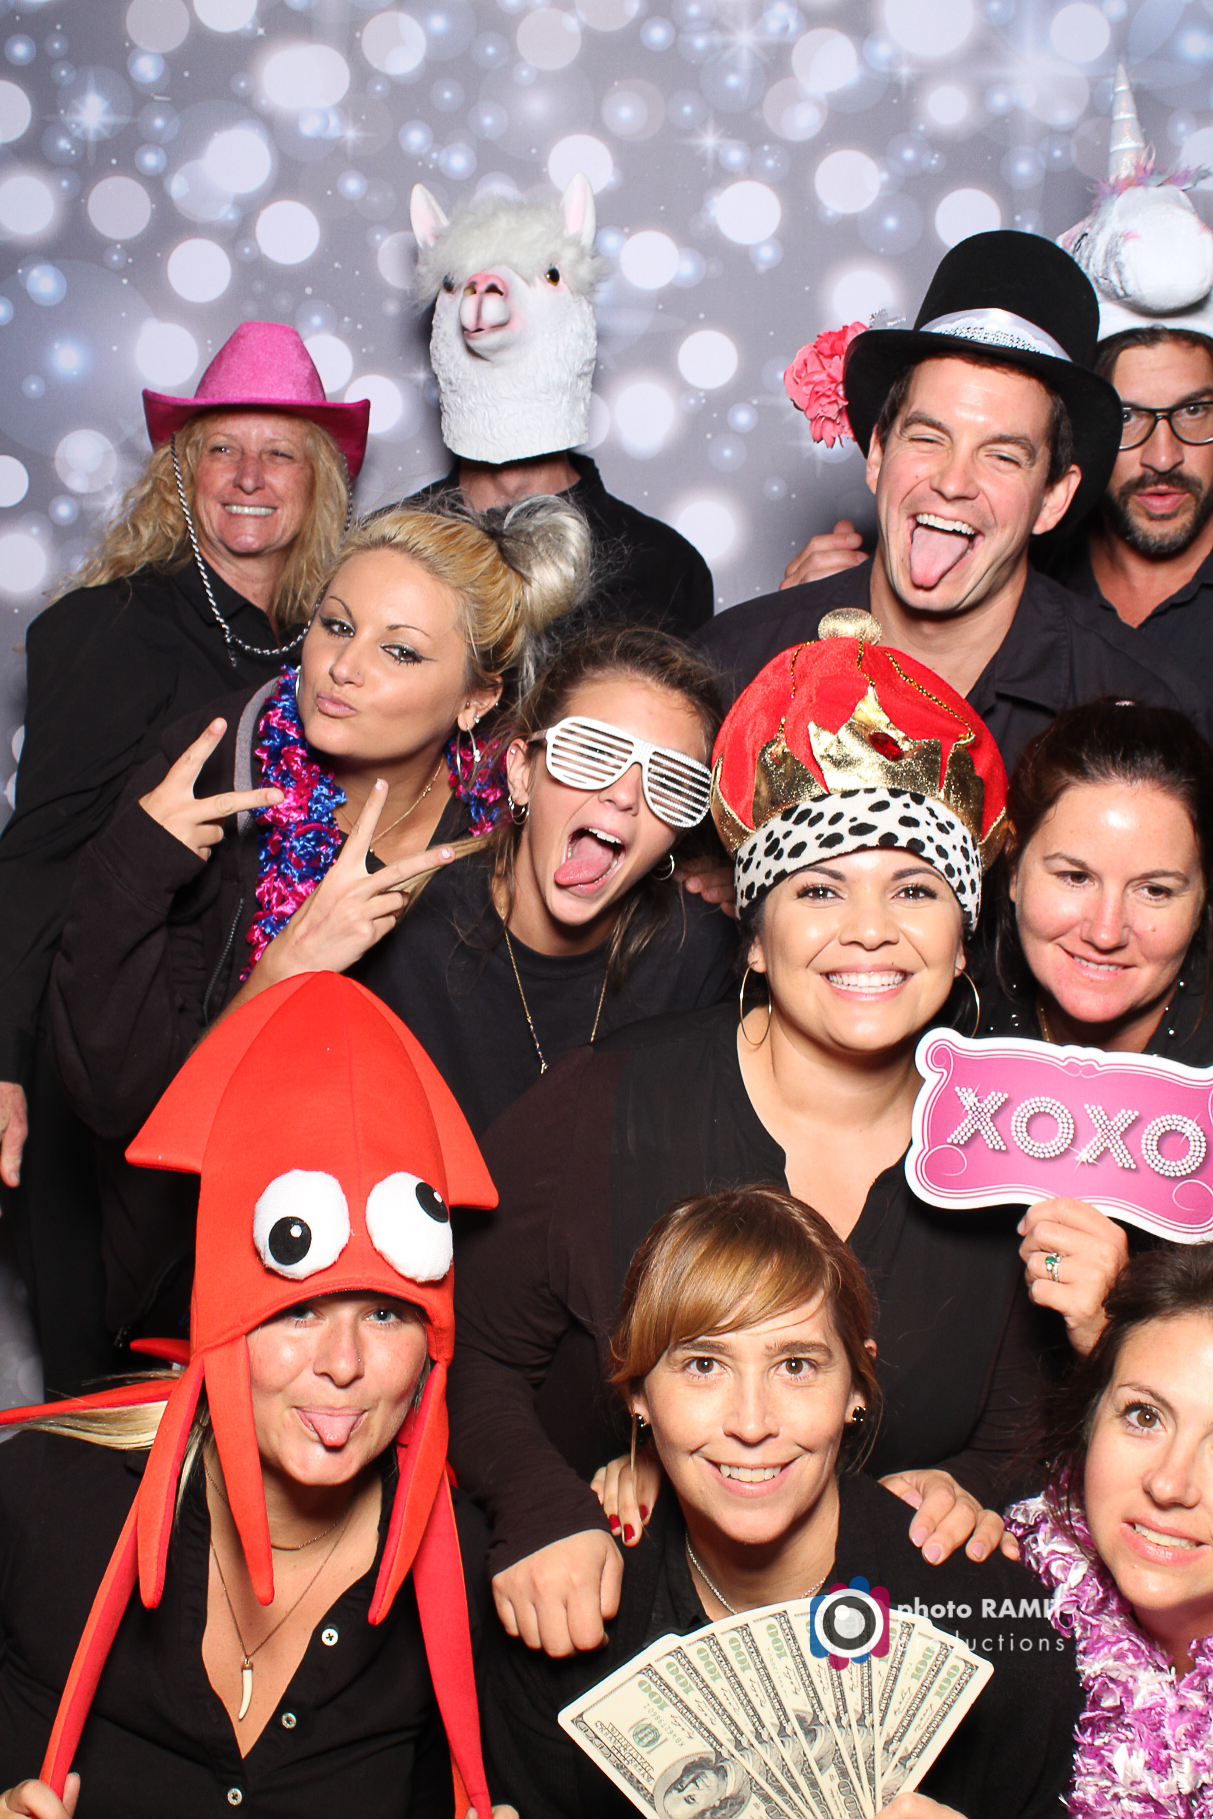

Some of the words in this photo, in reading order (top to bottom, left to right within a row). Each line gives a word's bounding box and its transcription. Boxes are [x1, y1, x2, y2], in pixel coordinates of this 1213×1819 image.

[946, 1085, 1207, 1177] XOXO
[728, 1636, 750, 1673] 100
[766, 1623, 787, 1660] 100
[665, 1661, 693, 1694] 100
[696, 1647, 720, 1681] 100
[910, 1645, 935, 1682] 100
[933, 1663, 960, 1699] 100
[637, 1678, 668, 1711] 100
